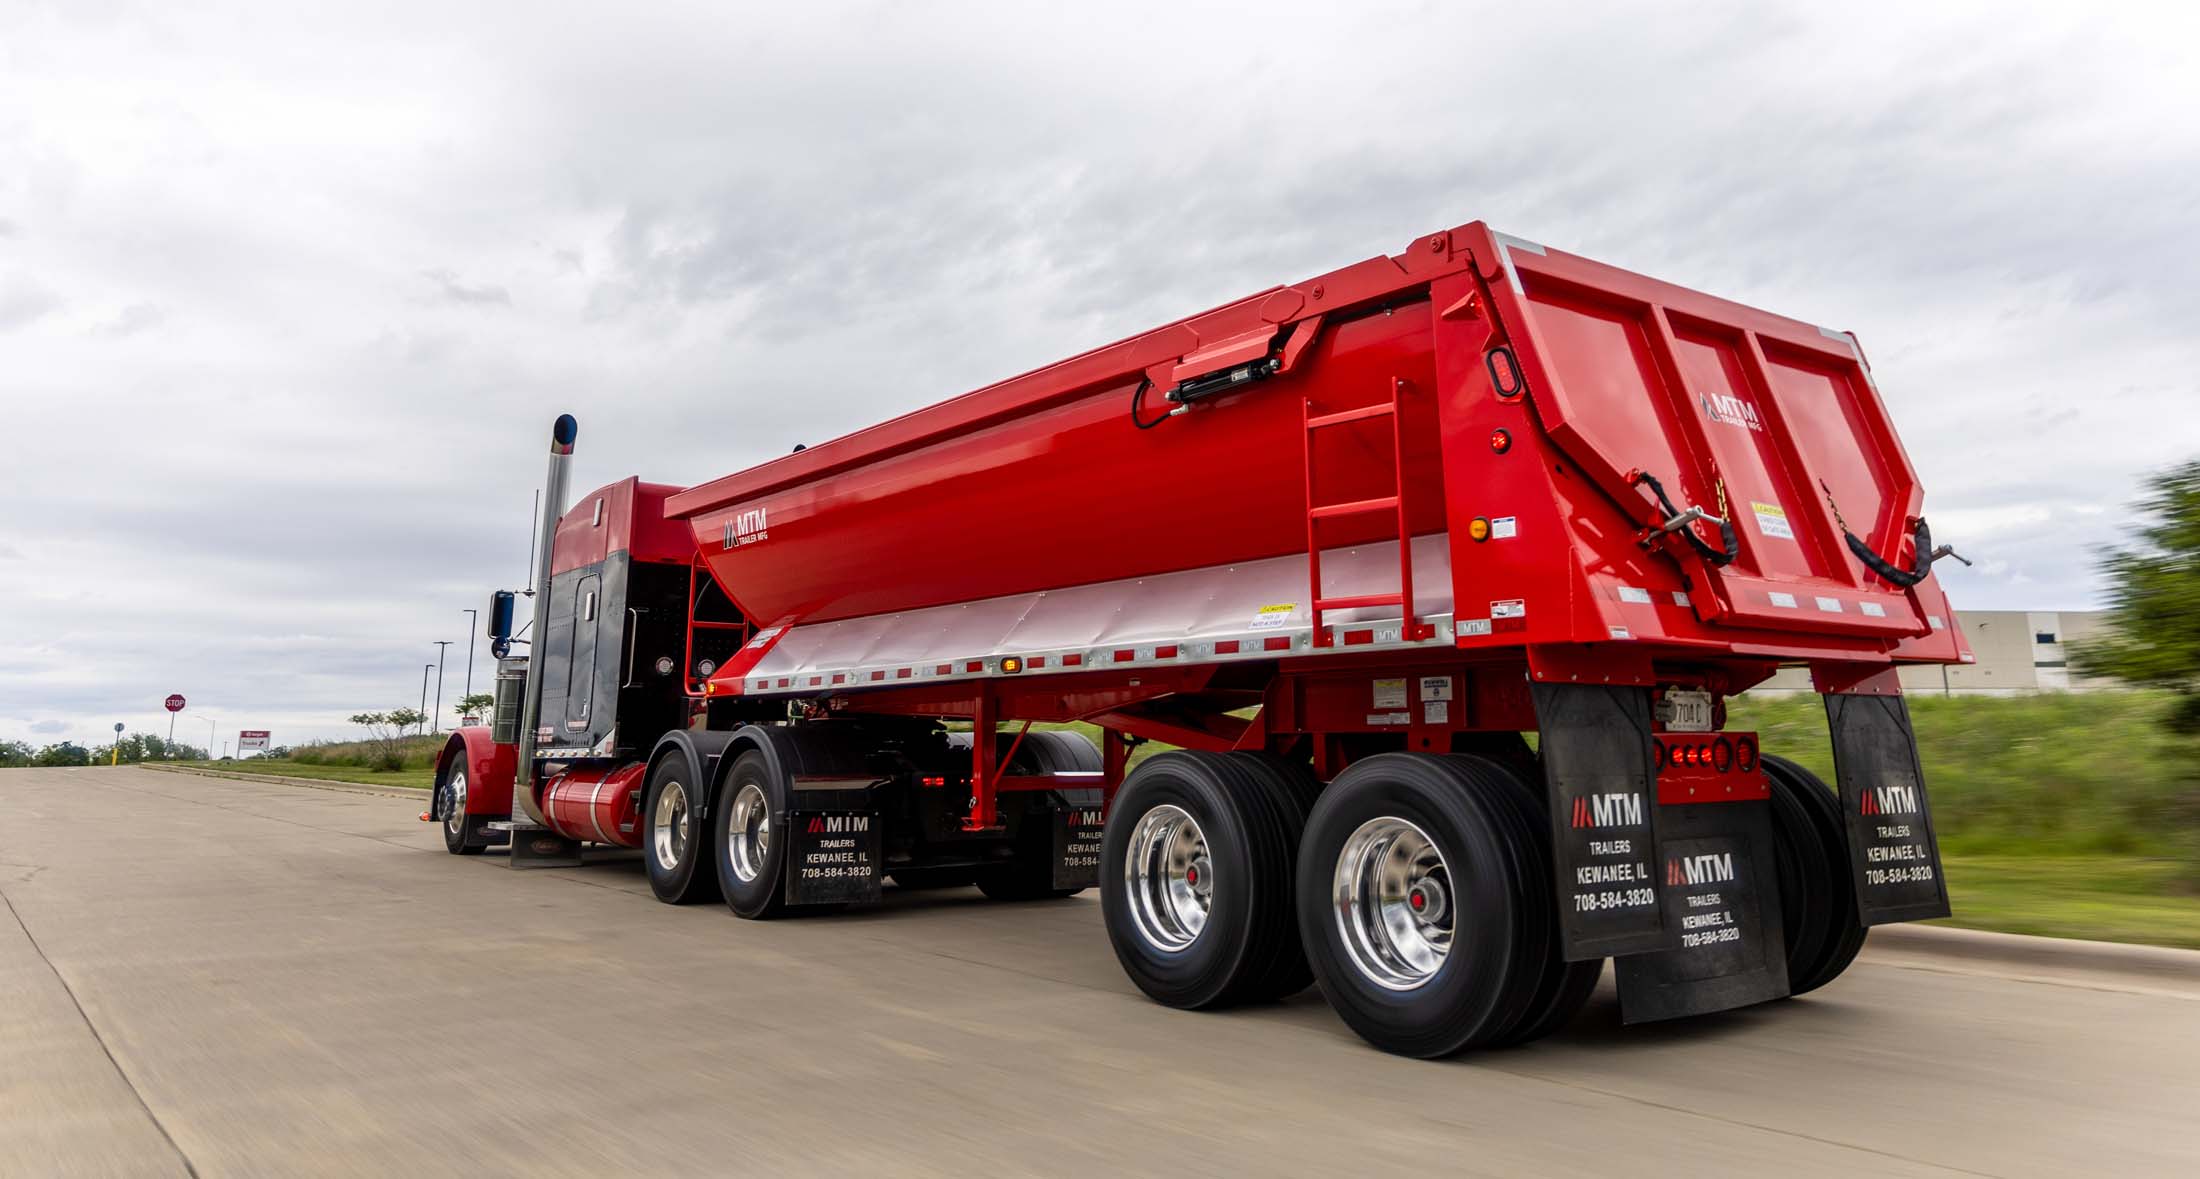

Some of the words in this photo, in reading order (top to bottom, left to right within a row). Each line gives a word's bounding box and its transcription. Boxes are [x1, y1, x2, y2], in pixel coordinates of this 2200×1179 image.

[1711, 393, 1758, 422] MTM
[737, 508, 767, 536] MTM
[739, 535, 756, 545] TRAILER
[757, 531, 768, 541] MFG
[166, 699, 184, 707] STOP
[1877, 786, 1917, 814] MTM
[1592, 793, 1642, 827] MTM
[1078, 831, 1104, 840] TRAILER
[1876, 825, 1911, 839] TRAILERS
[820, 839, 856, 848] TRAILERS
[1067, 843, 1102, 854] KEWANE
[1589, 840, 1631, 855] TRAILERS
[807, 852, 857, 864] KEWANEE,
[858, 851, 868, 862] IL
[1915, 844, 1926, 859] IL
[801, 866, 872, 879] 708-584-3820
[1577, 863, 1635, 885] KEWANEE,
[1636, 862, 1648, 880] IL
[1684, 853, 1734, 885] MTM
[1865, 865, 1933, 885] 708-584-3820
[1574, 888, 1655, 912] 708-584-3820
[1686, 893, 1721, 908] TRAILERS
[1723, 911, 1734, 924] IL
